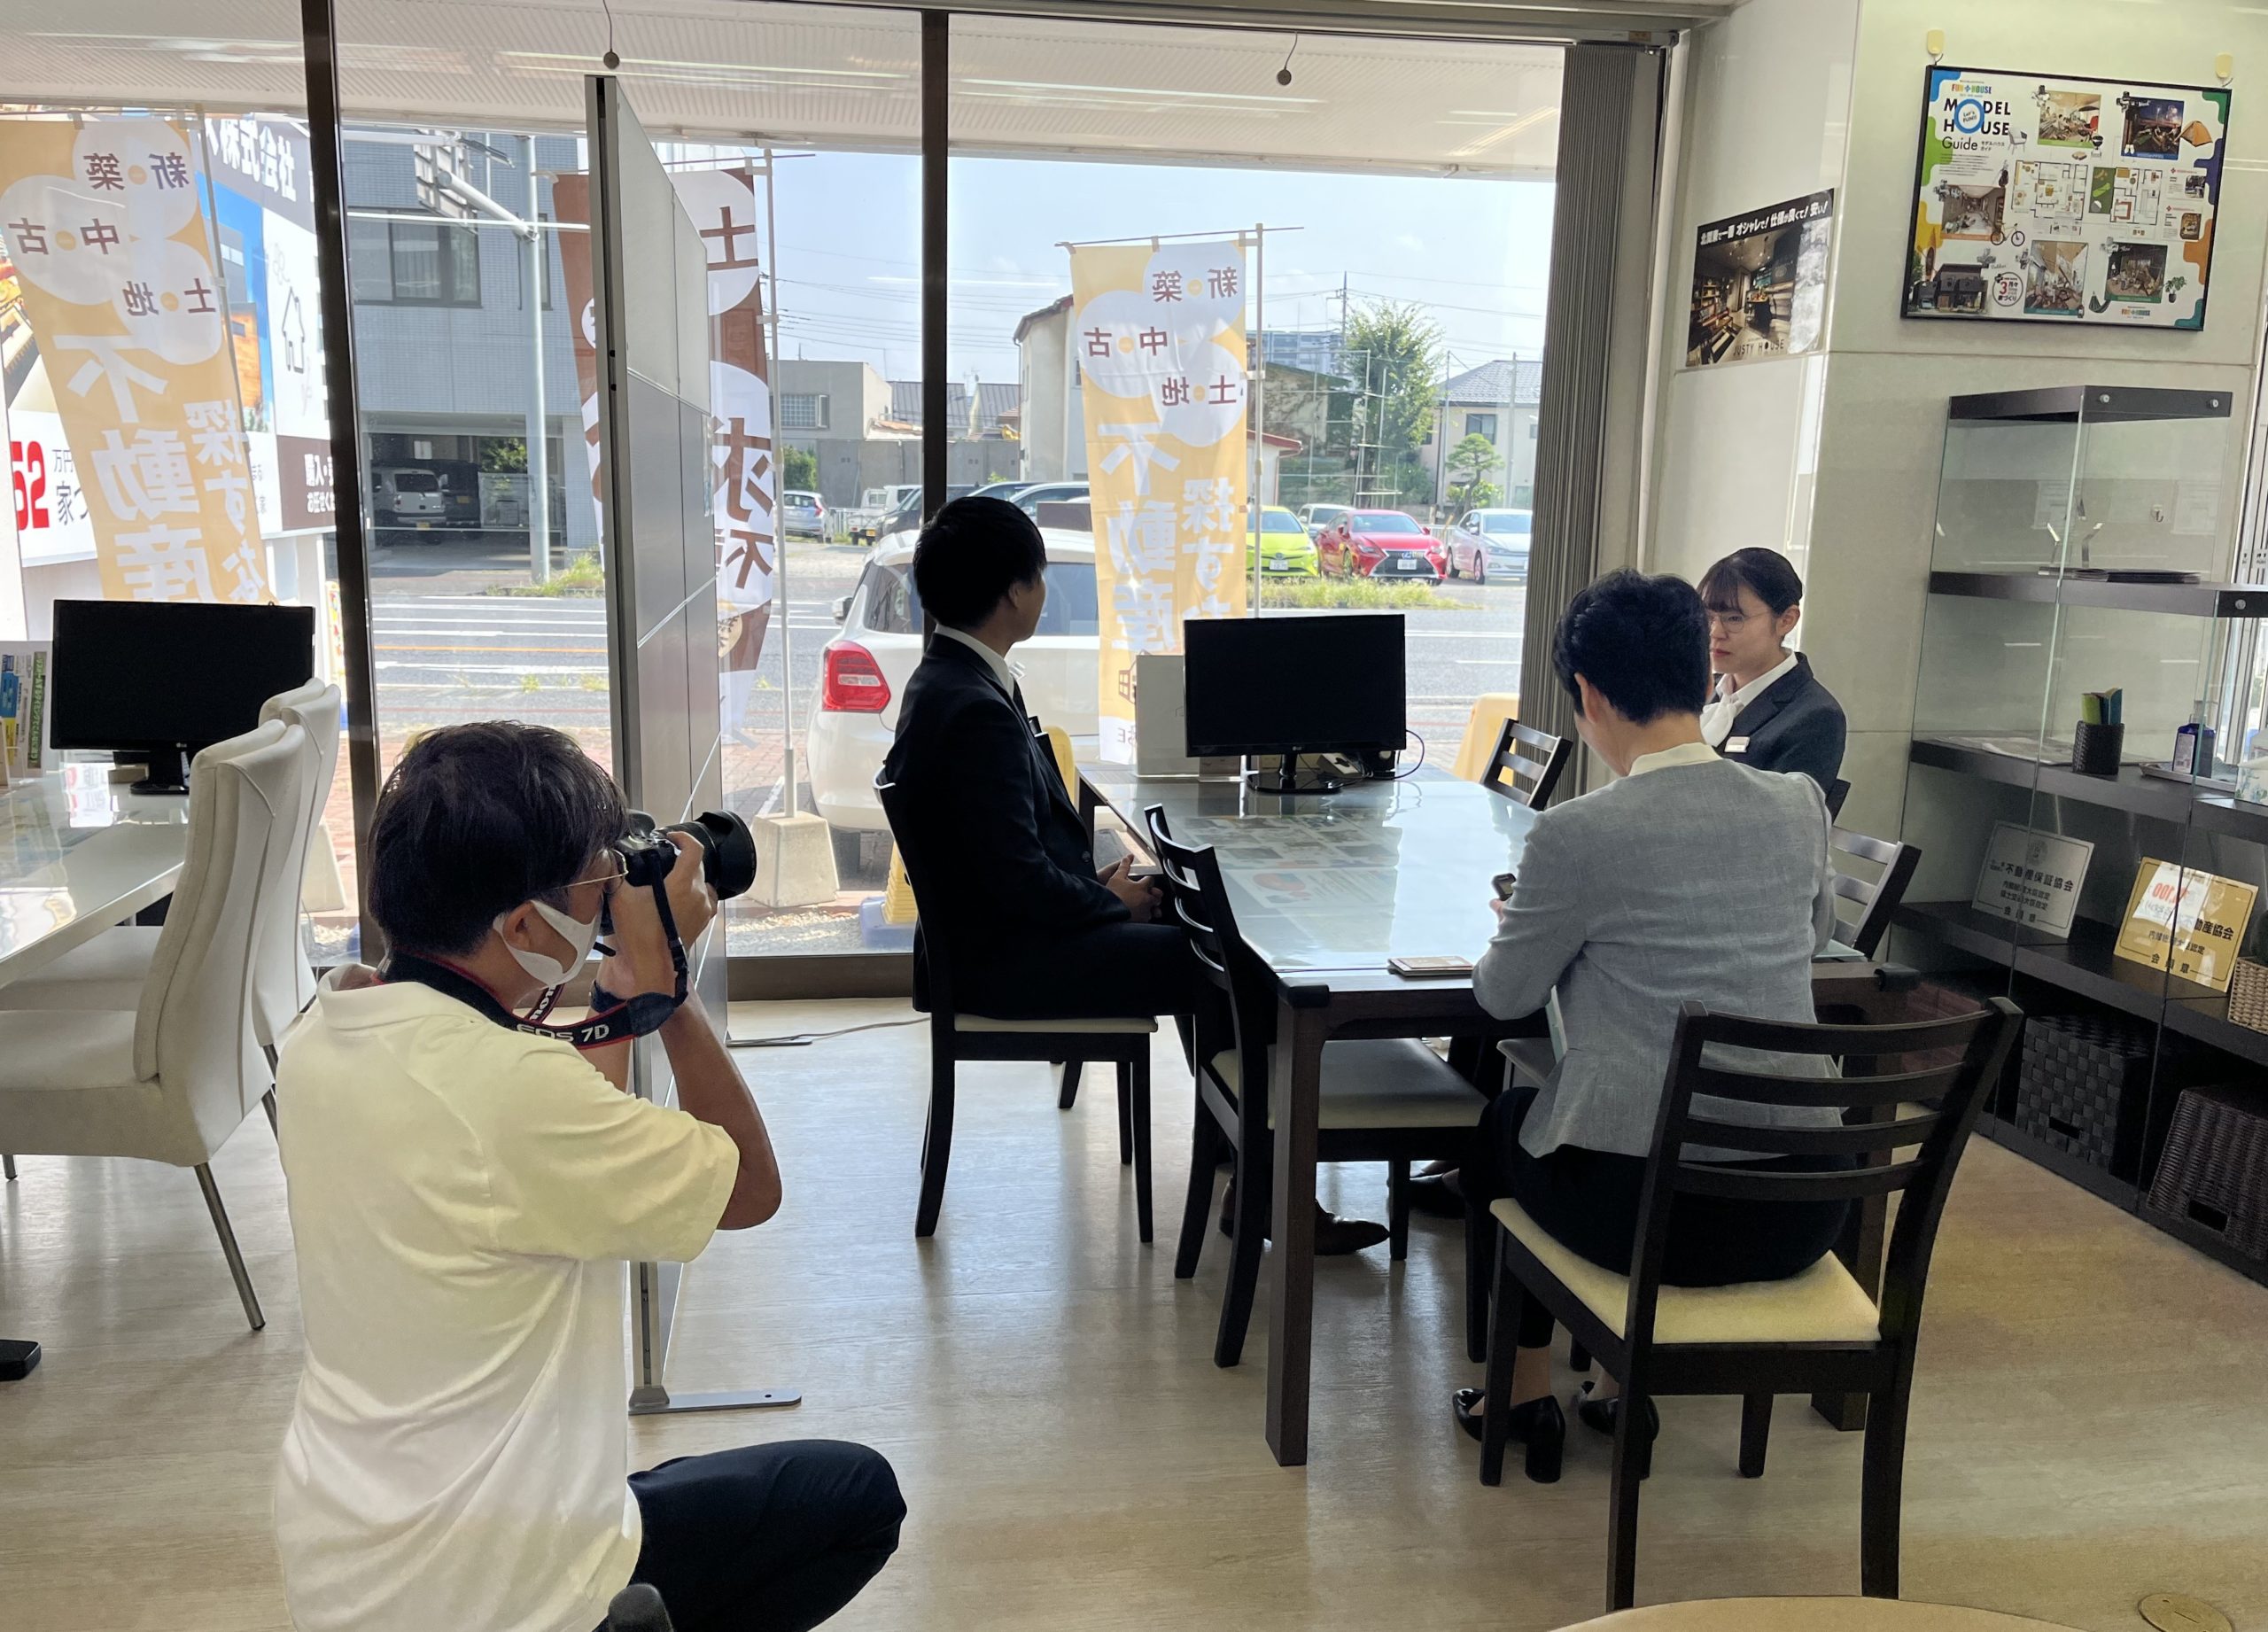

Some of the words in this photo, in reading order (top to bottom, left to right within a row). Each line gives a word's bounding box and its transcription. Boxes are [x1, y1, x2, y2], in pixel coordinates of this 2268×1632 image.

[1944, 98, 2011, 115] MODEL
[1944, 119, 2009, 136] HOUSE
[1942, 136, 1978, 151] Guide
[1734, 343, 1754, 356] JUSTY
[1759, 338, 1785, 352] HOUSE
[581, 1024, 610, 1043] 7D
